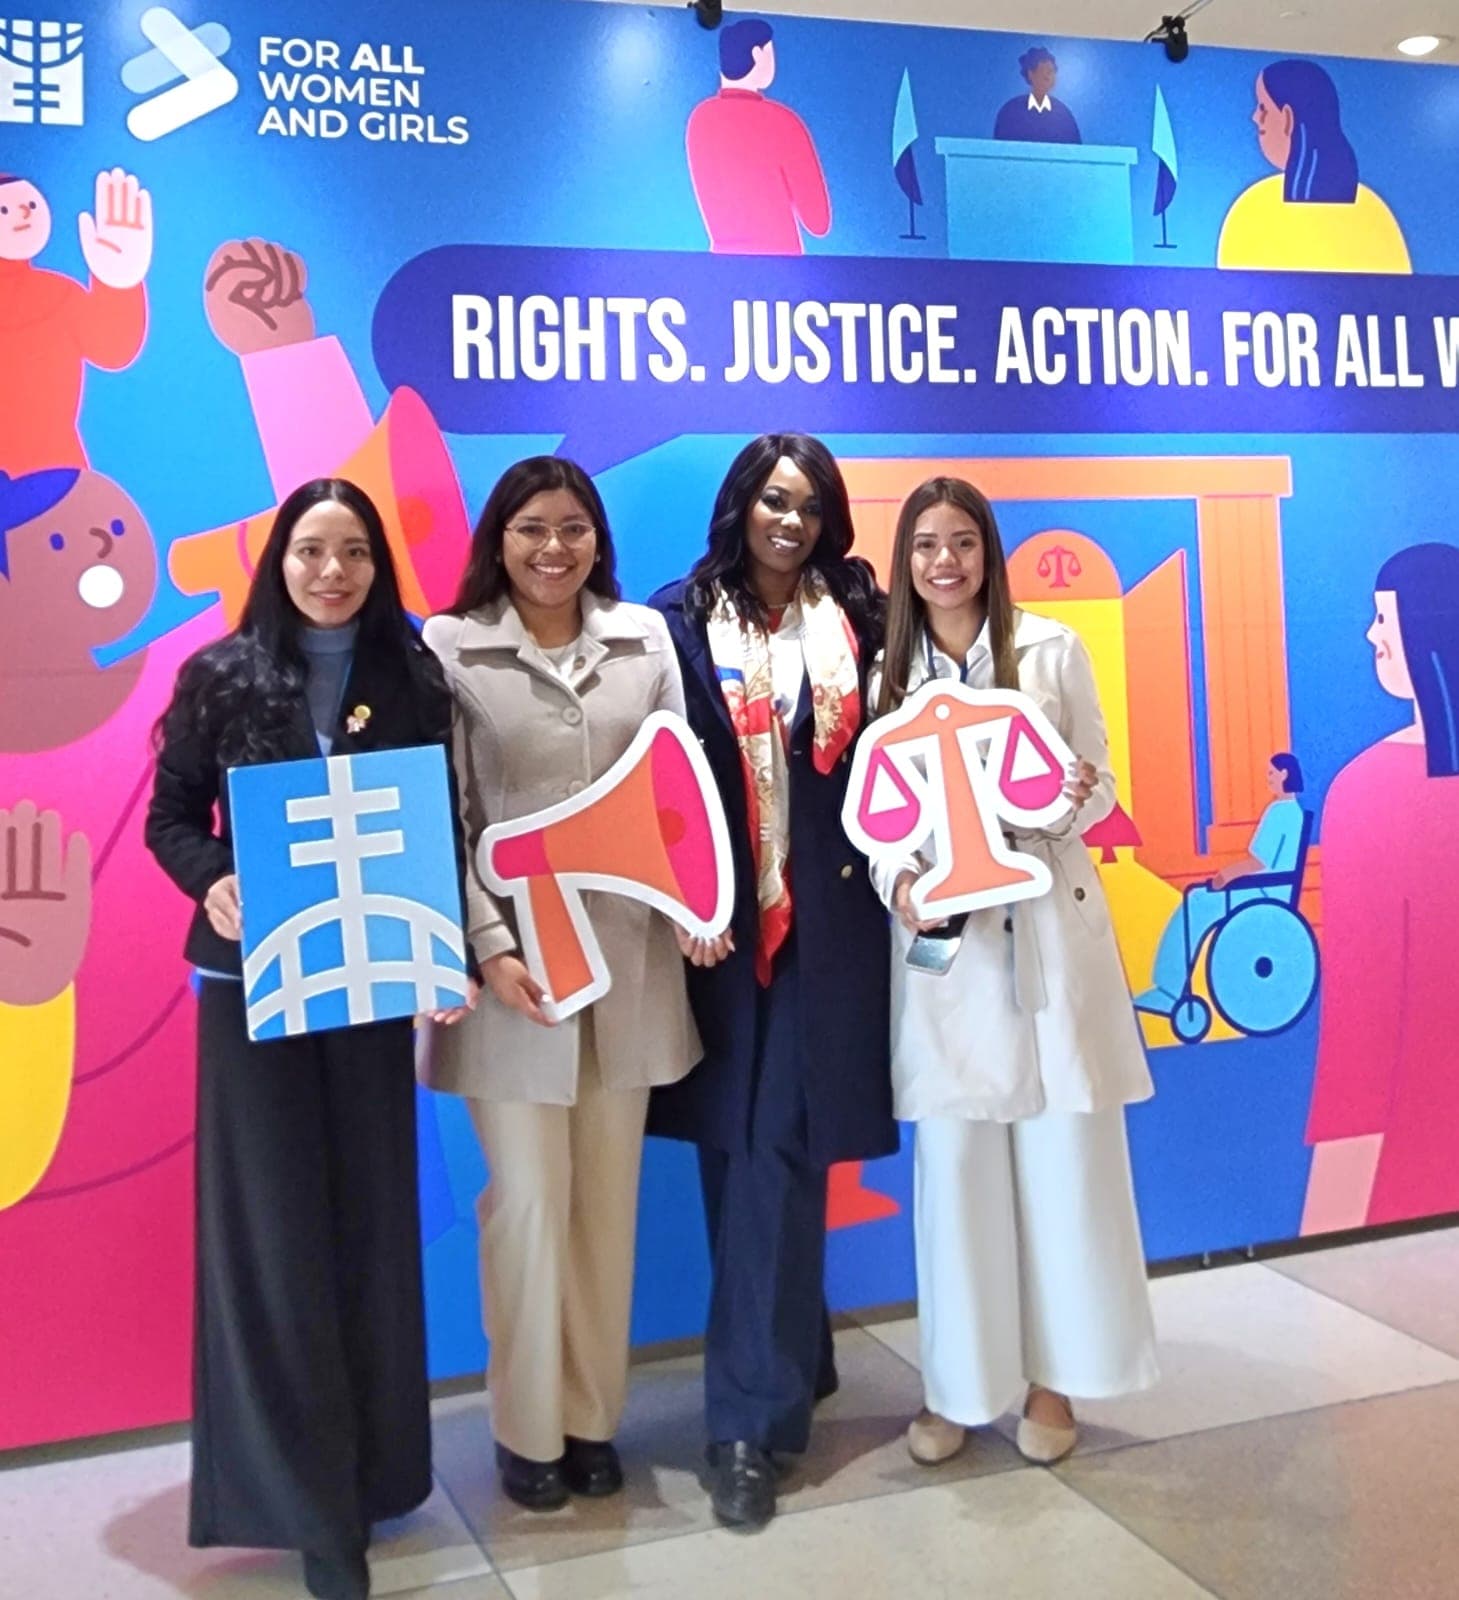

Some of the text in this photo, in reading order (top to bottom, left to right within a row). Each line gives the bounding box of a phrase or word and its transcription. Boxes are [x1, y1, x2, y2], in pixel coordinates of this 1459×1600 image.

[260, 36, 425, 76] FOR ALL
[258, 71, 420, 108] WOMEN
[258, 106, 469, 145] AND GIRLS
[452, 294, 706, 383] RIGHTS.
[724, 299, 977, 384] JUSTICE.
[995, 306, 1209, 387] ACTION.
[1222, 311, 1321, 388] FOR
[1334, 313, 1424, 387] ALL
